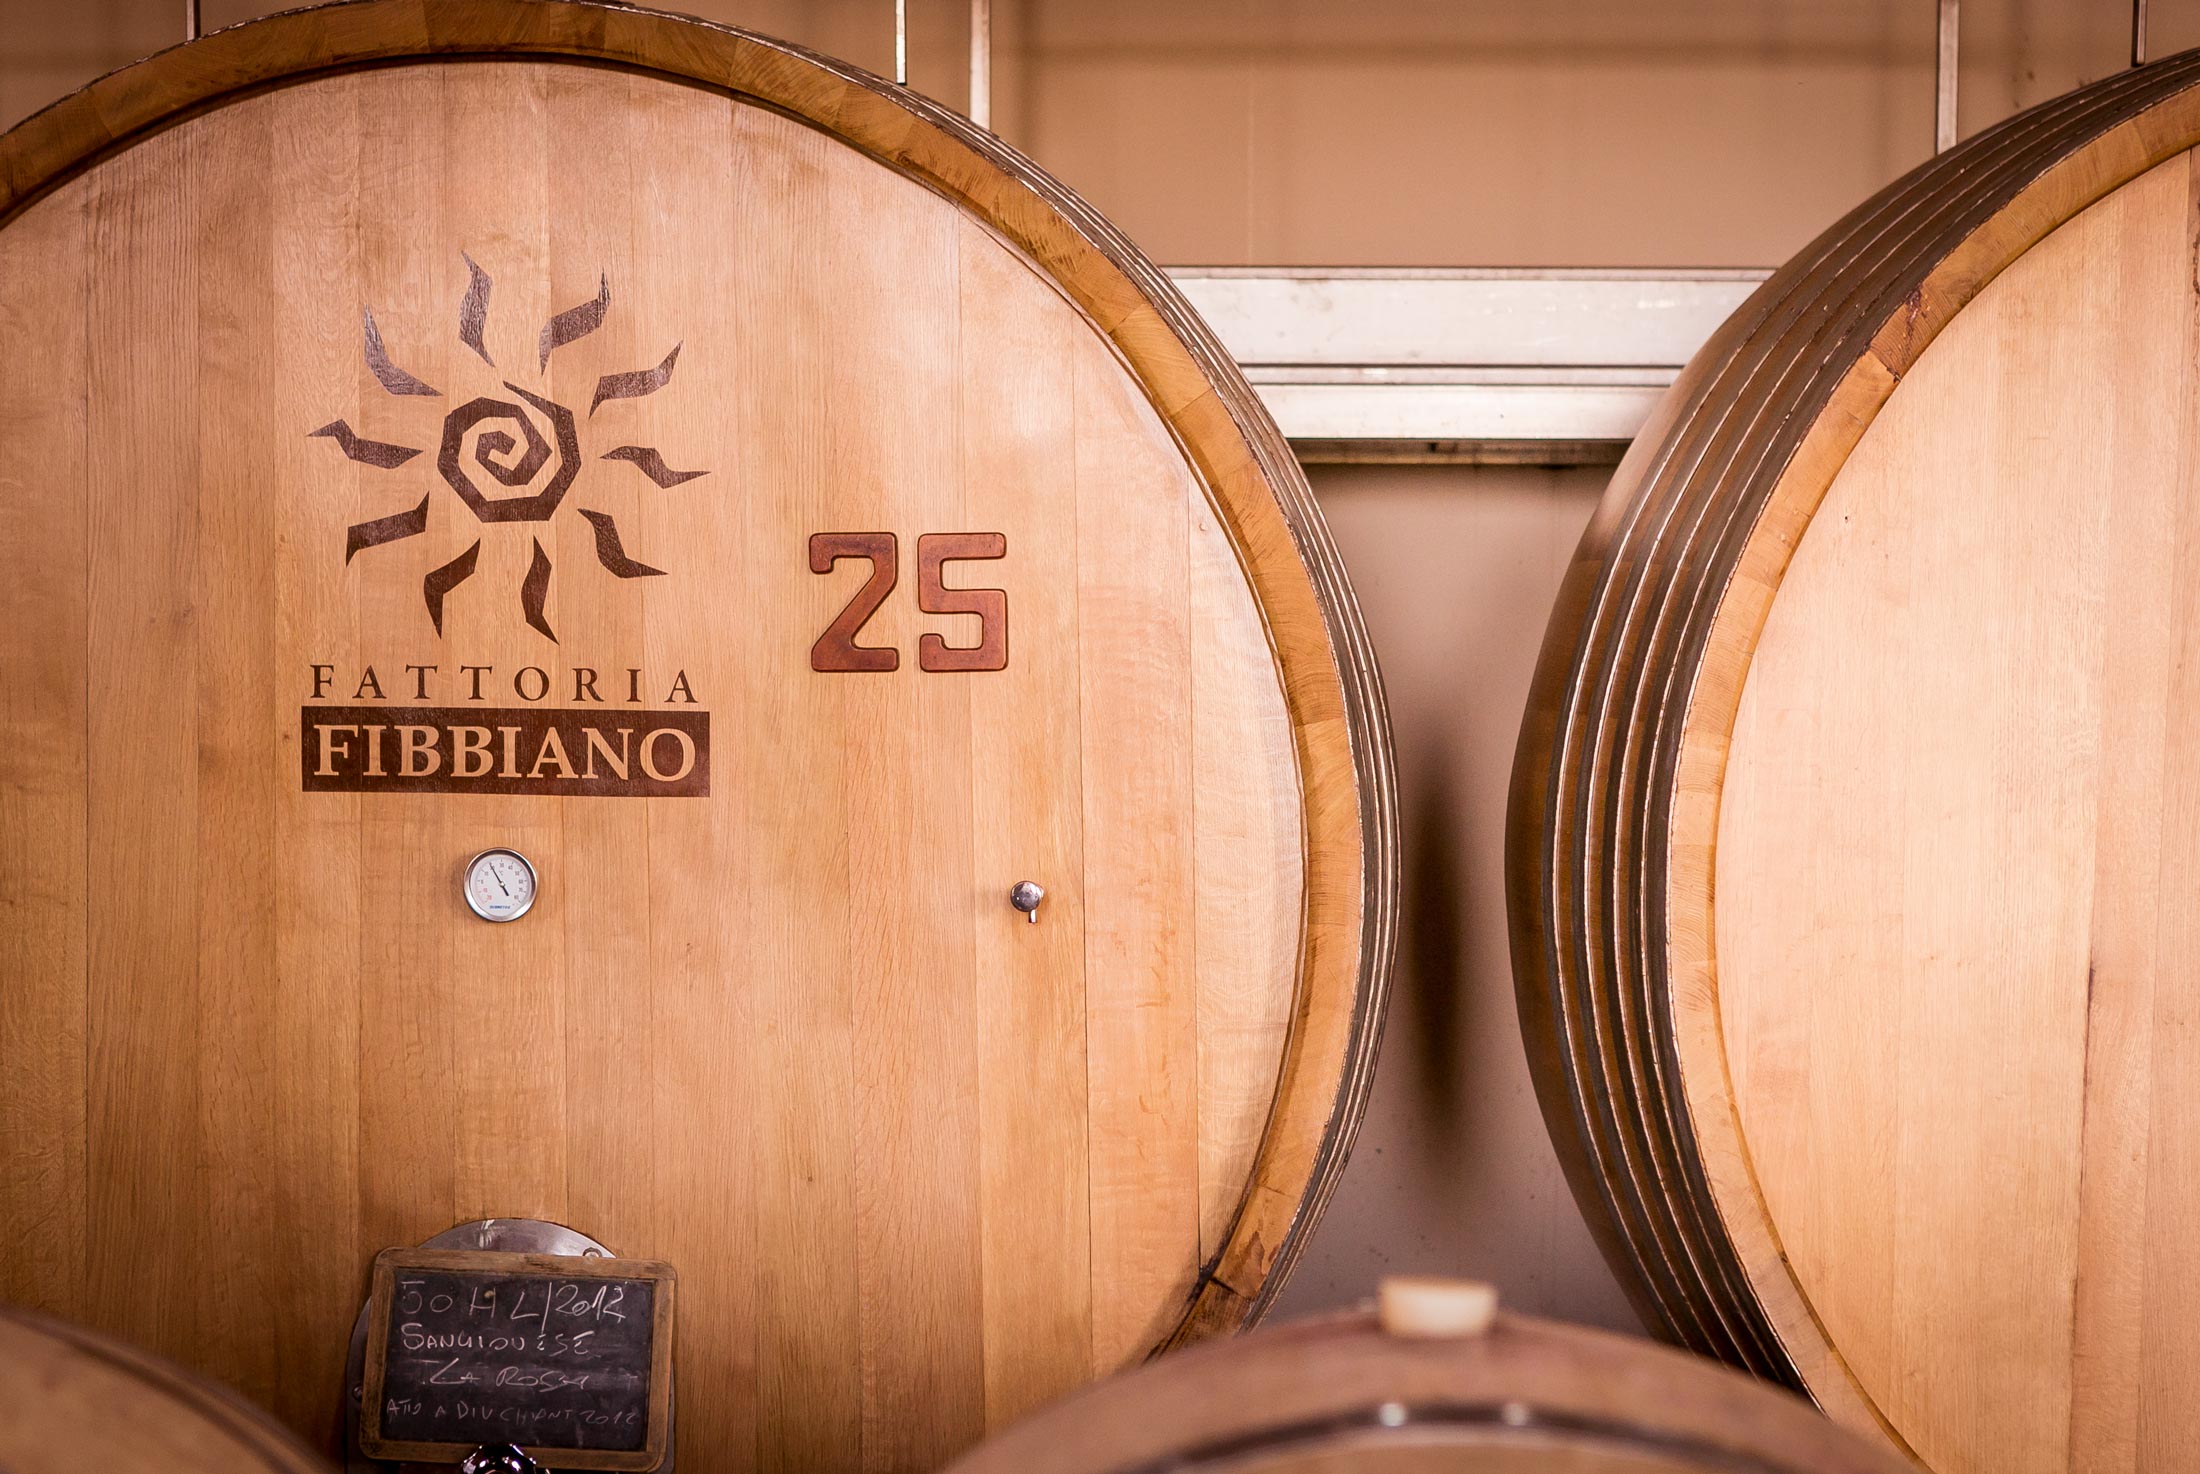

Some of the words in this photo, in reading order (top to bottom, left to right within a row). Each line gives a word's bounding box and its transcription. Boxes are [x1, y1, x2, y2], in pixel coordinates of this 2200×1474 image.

[808, 531, 1009, 673] 25
[309, 663, 698, 704] FATTORIA
[312, 723, 696, 782] FIBBIANO
